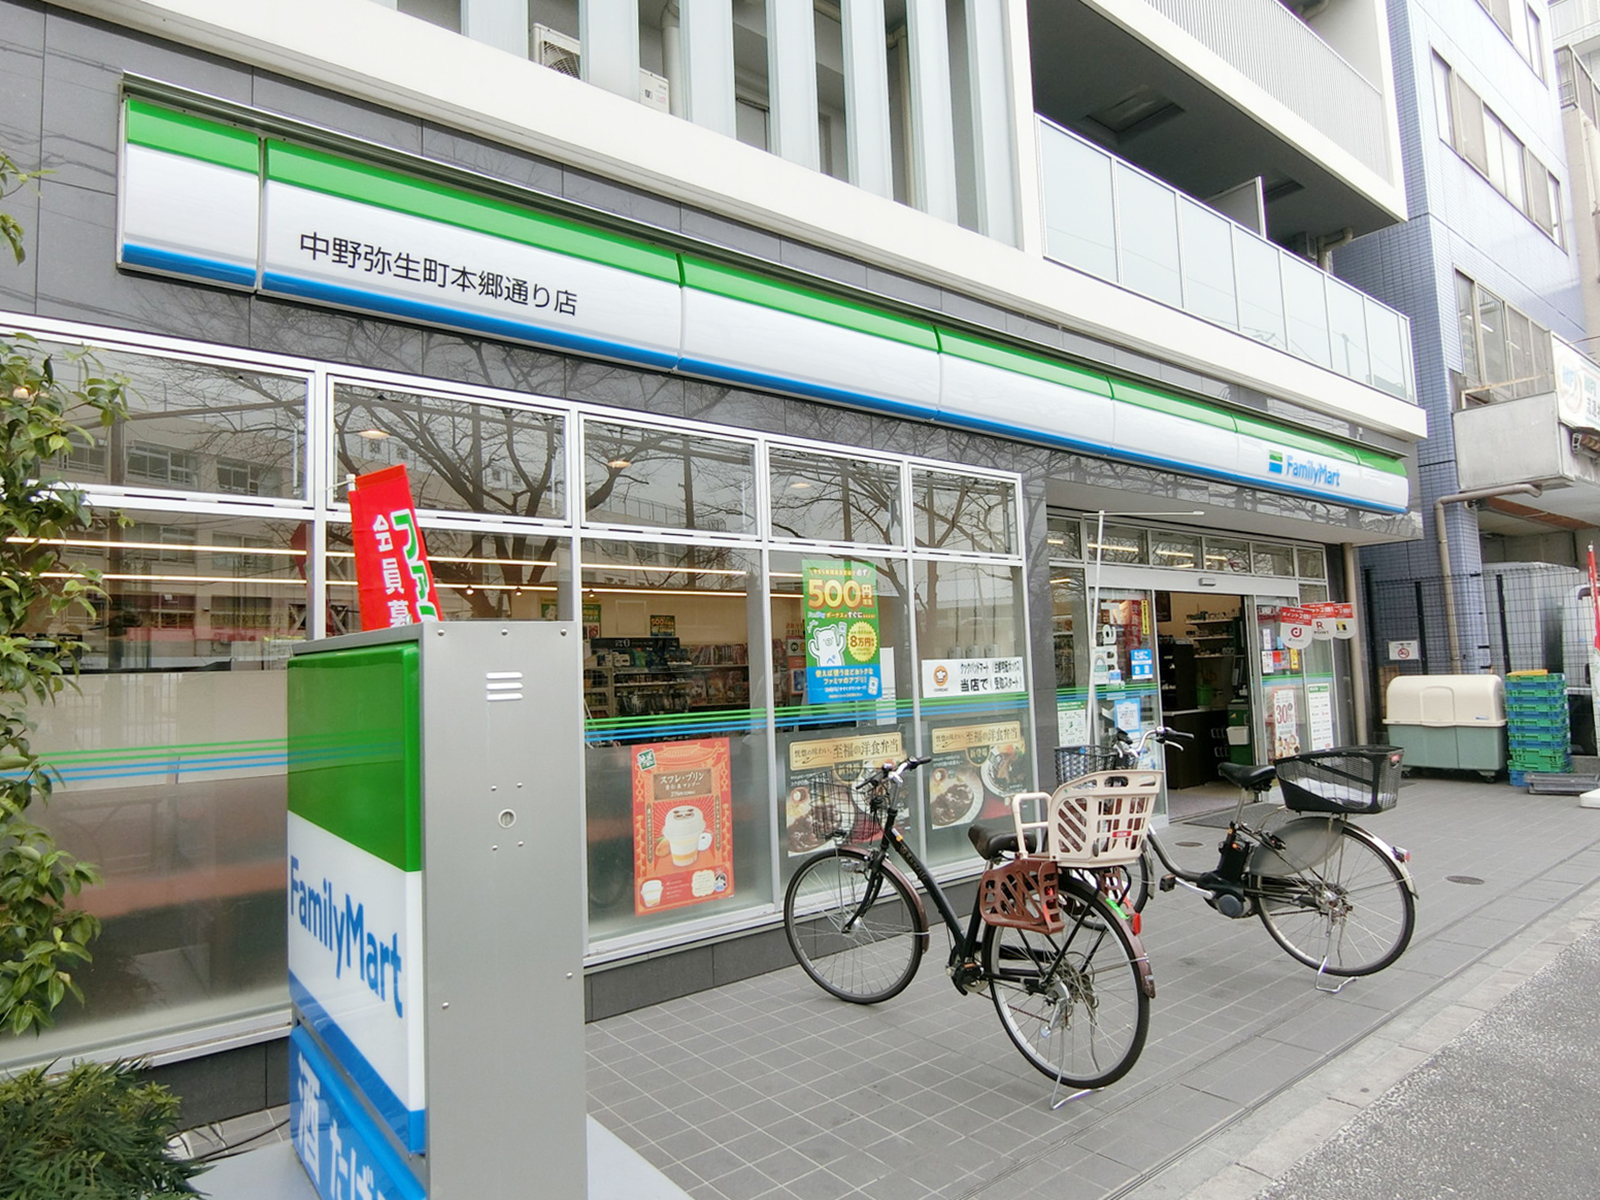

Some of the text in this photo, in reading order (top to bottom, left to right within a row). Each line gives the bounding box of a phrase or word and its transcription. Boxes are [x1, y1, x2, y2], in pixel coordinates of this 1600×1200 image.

[300, 231, 578, 316] 中野弥生町本郷通り店
[1286, 455, 1340, 487] FamilyMart
[960, 678, 989, 692] 当店で
[290, 855, 403, 1018] FamilyMart
